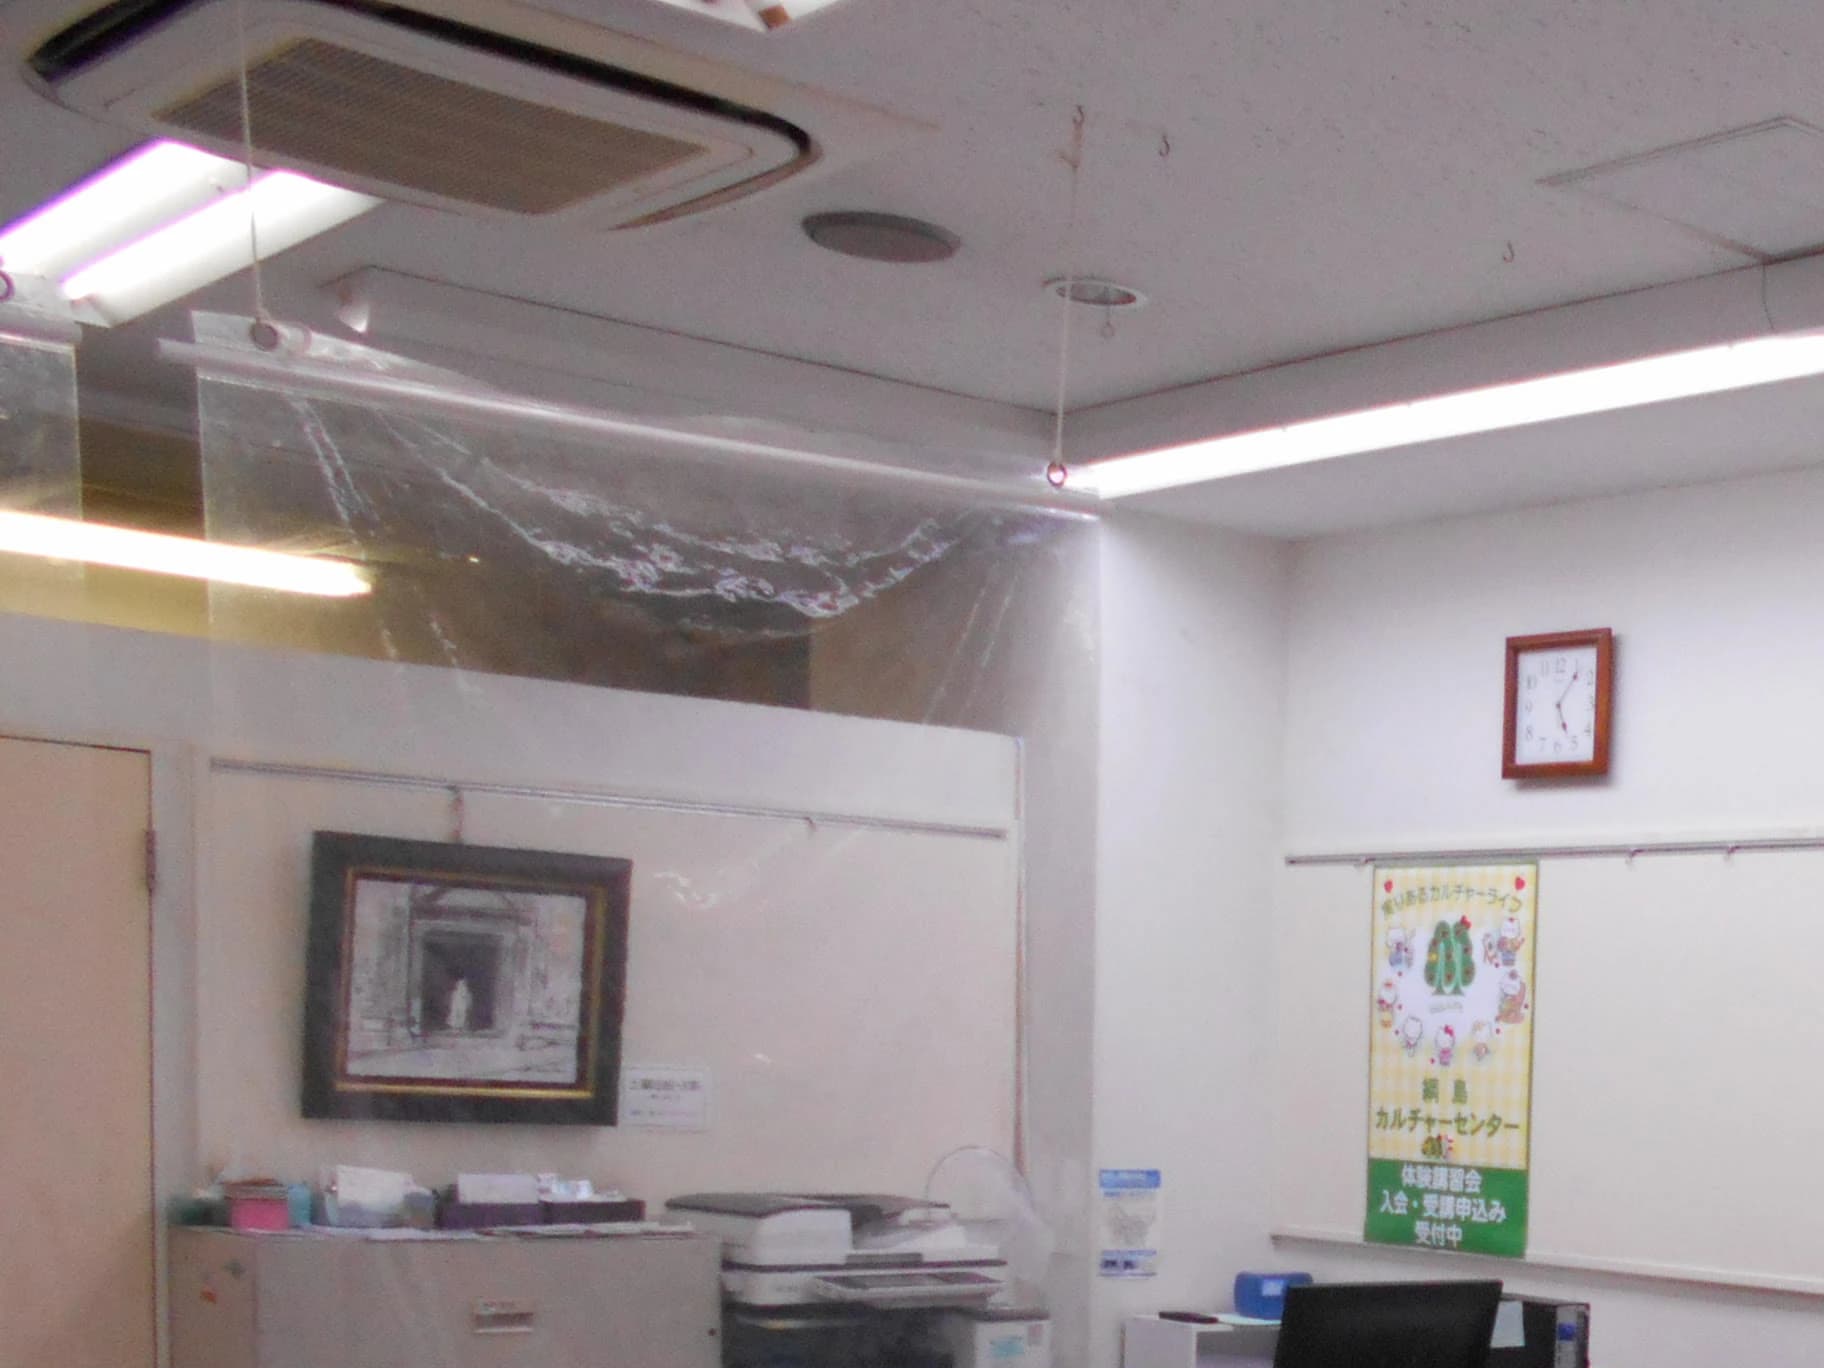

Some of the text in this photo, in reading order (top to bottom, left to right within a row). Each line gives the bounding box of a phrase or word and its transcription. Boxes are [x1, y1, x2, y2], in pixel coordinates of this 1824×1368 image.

[1375, 1106, 1521, 1138] カルチャーセンター
[1401, 1163, 1482, 1193] 体験講習会
[1414, 1219, 1463, 1247] 受付中
